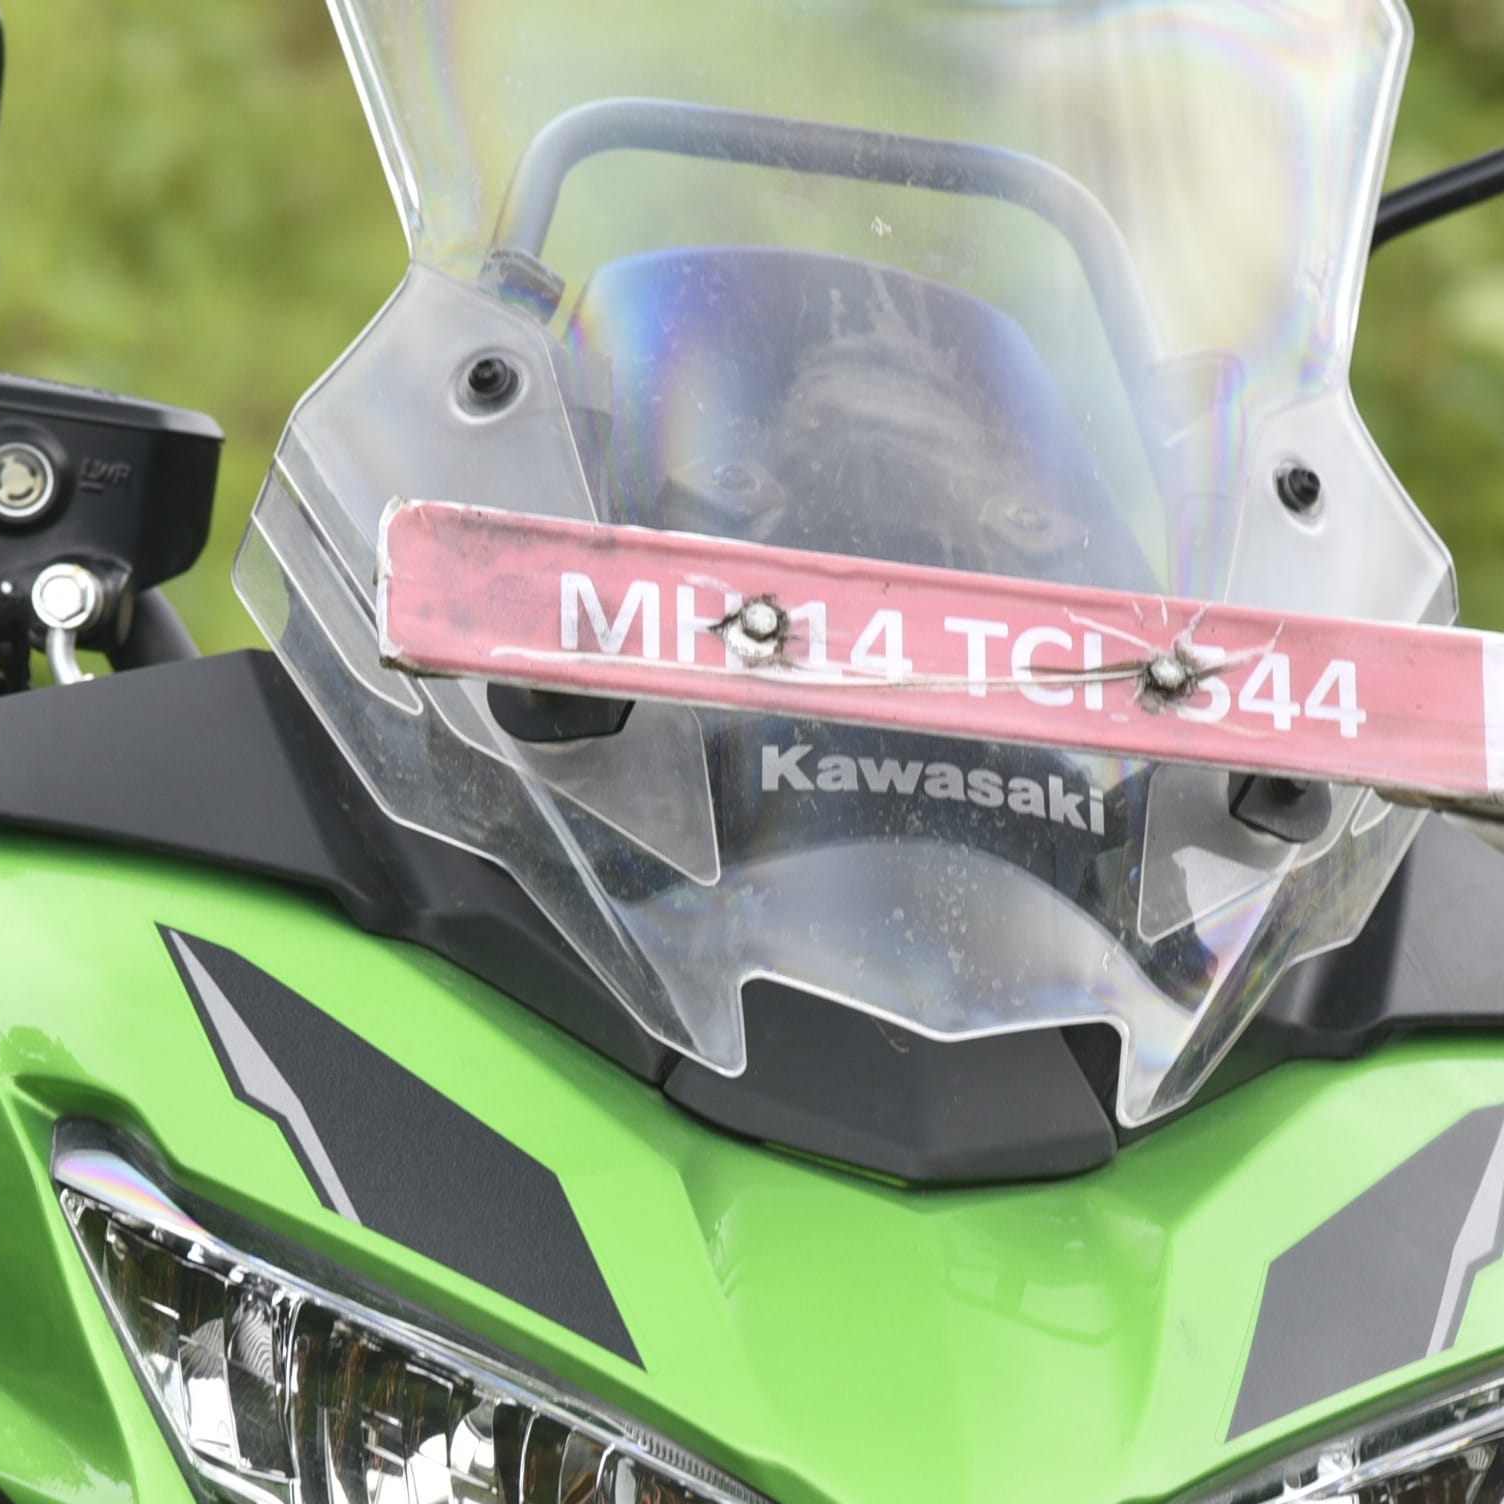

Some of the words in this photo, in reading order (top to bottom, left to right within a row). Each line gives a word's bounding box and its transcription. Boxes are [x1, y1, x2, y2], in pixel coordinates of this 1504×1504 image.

[560, 571, 745, 671] MH
[789, 599, 914, 681] 14
[1175, 643, 1367, 738] 544
[761, 743, 1106, 837] Kawasaki
